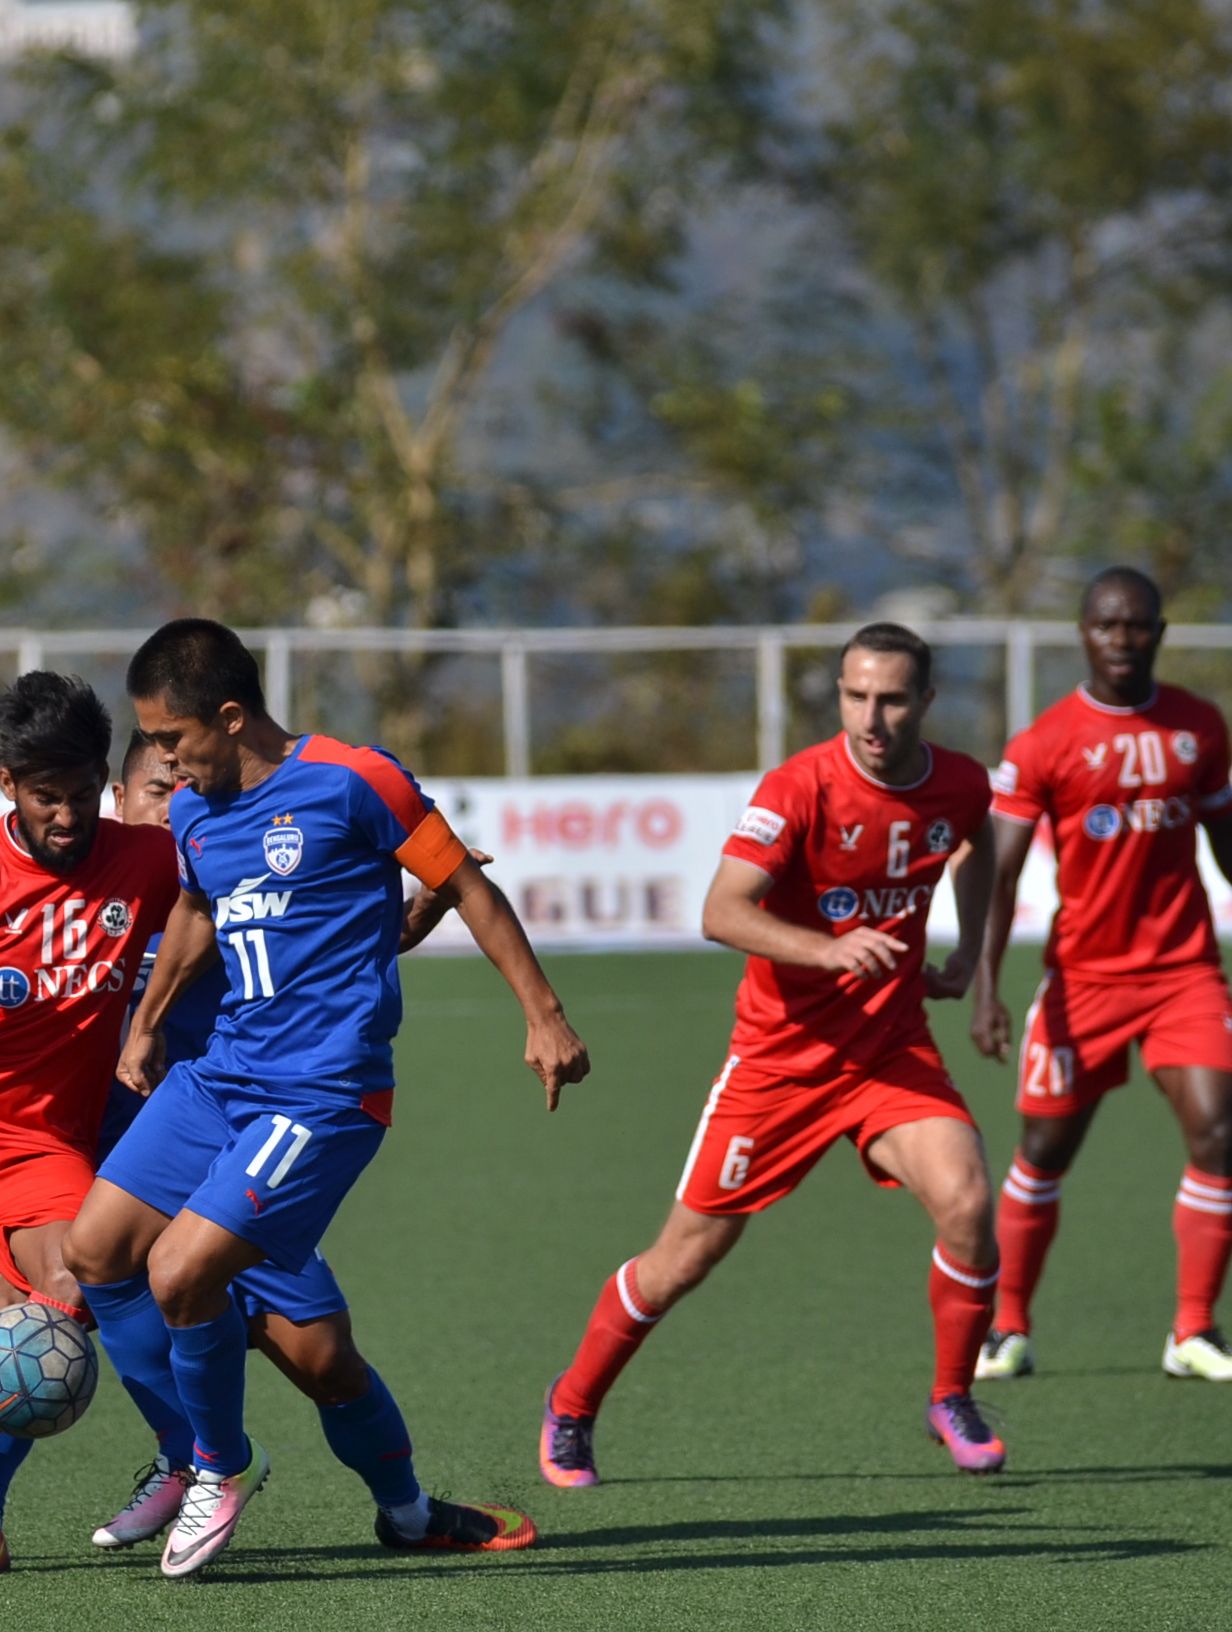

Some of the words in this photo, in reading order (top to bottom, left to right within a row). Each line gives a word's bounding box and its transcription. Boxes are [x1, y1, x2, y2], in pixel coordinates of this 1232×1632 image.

[1113, 730, 1168, 789] 20
[887, 820, 911, 878] 6
[215, 890, 293, 930] JSW
[858, 884, 933, 919] NEC
[41, 899, 87, 965] 16
[34, 957, 126, 1002] NECS
[228, 929, 275, 1001] 11
[1027, 1042, 1073, 1097] 20
[245, 1114, 313, 1189] 11
[719, 1135, 755, 1190] 6
